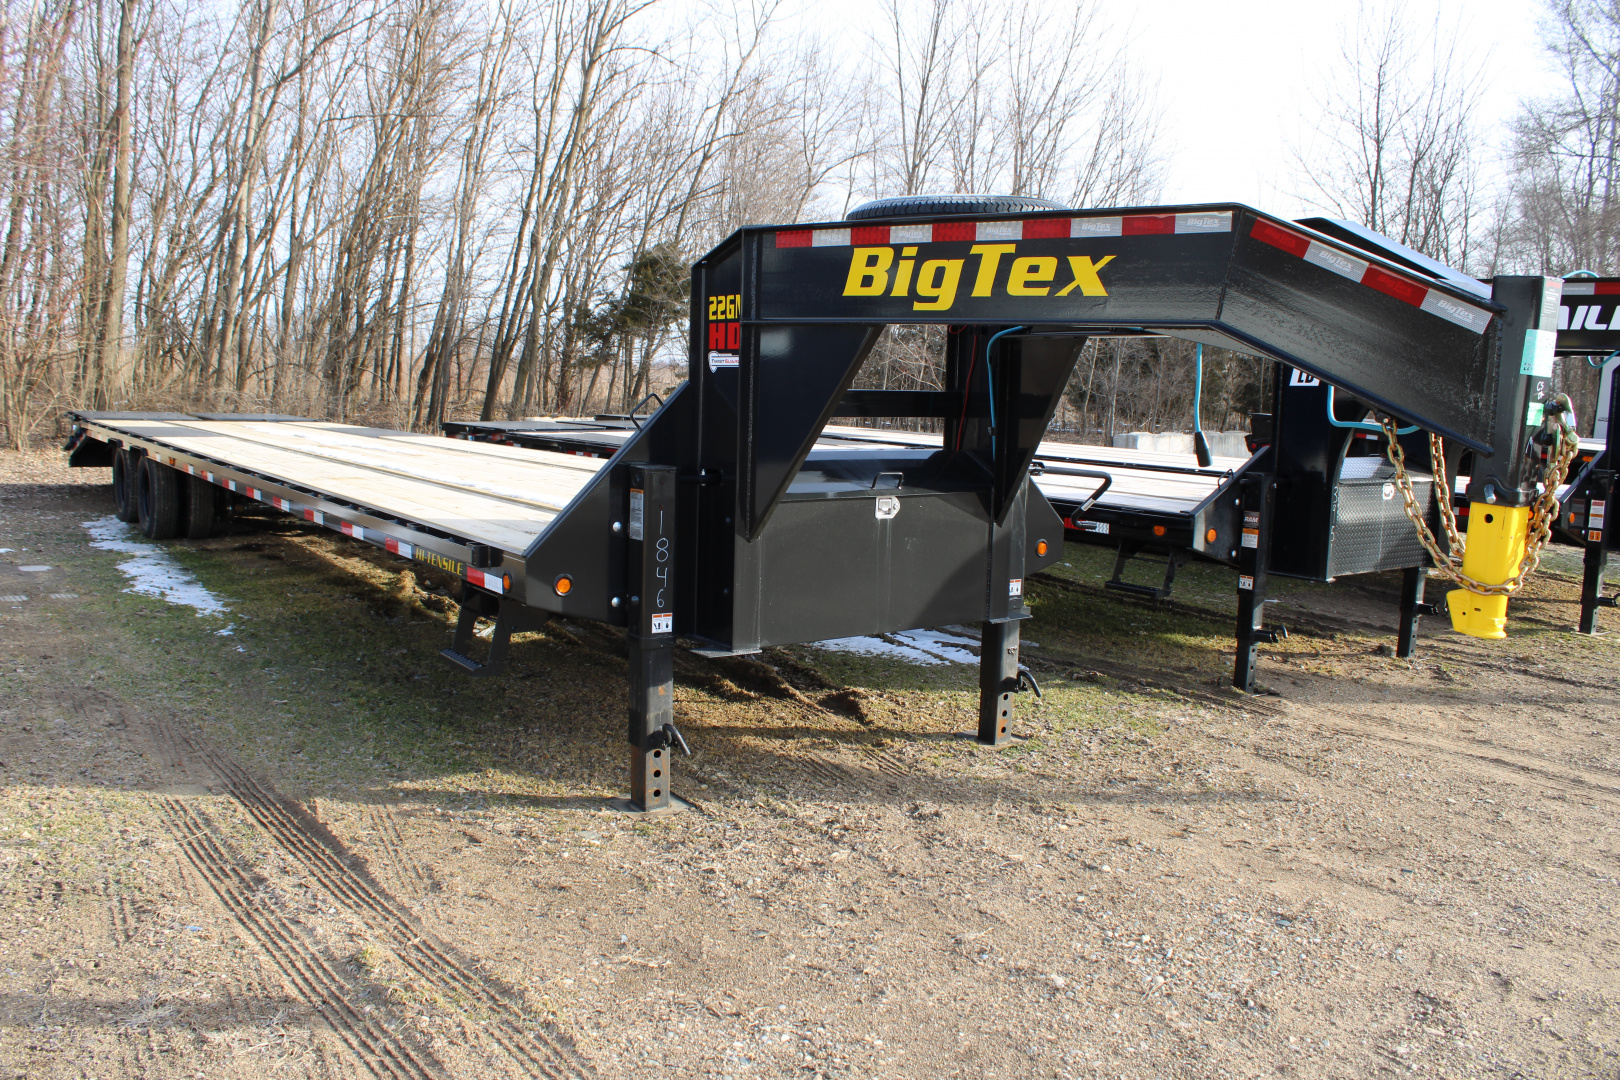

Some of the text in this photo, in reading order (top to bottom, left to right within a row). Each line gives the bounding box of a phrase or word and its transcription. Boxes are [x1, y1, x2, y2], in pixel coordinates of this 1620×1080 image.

[842, 243, 1117, 311] BigTex
[708, 322, 740, 350] HD
[415, 547, 464, 576] HI-TENSILE
[655, 510, 669, 608] 1846
